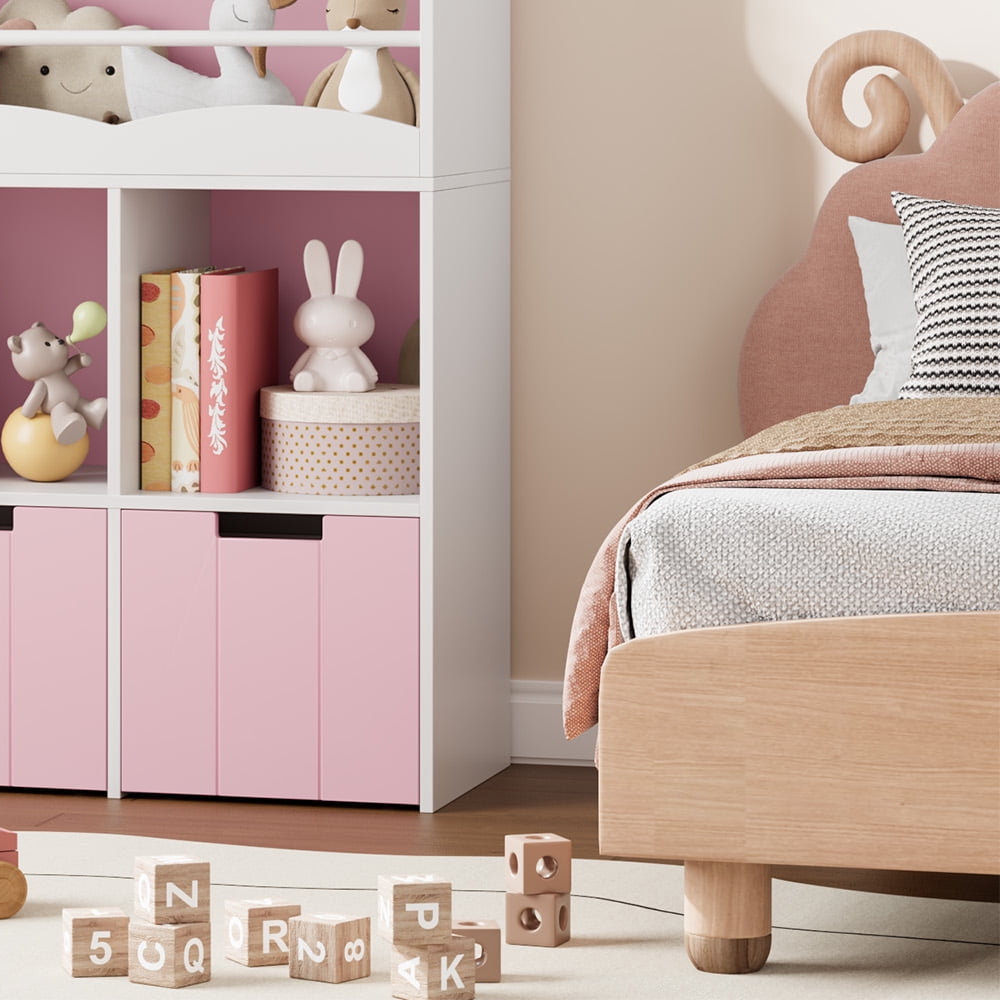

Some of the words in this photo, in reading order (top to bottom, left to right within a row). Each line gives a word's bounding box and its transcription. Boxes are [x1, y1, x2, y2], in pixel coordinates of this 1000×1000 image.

[405, 903, 439, 930] P
[89, 931, 112, 965] 5
[262, 920, 289, 953] R
[298, 937, 326, 963] 2
[344, 938, 365, 962] 8
[184, 937, 205, 973] Q
[398, 956, 421, 990] A
[441, 953, 465, 991] K
